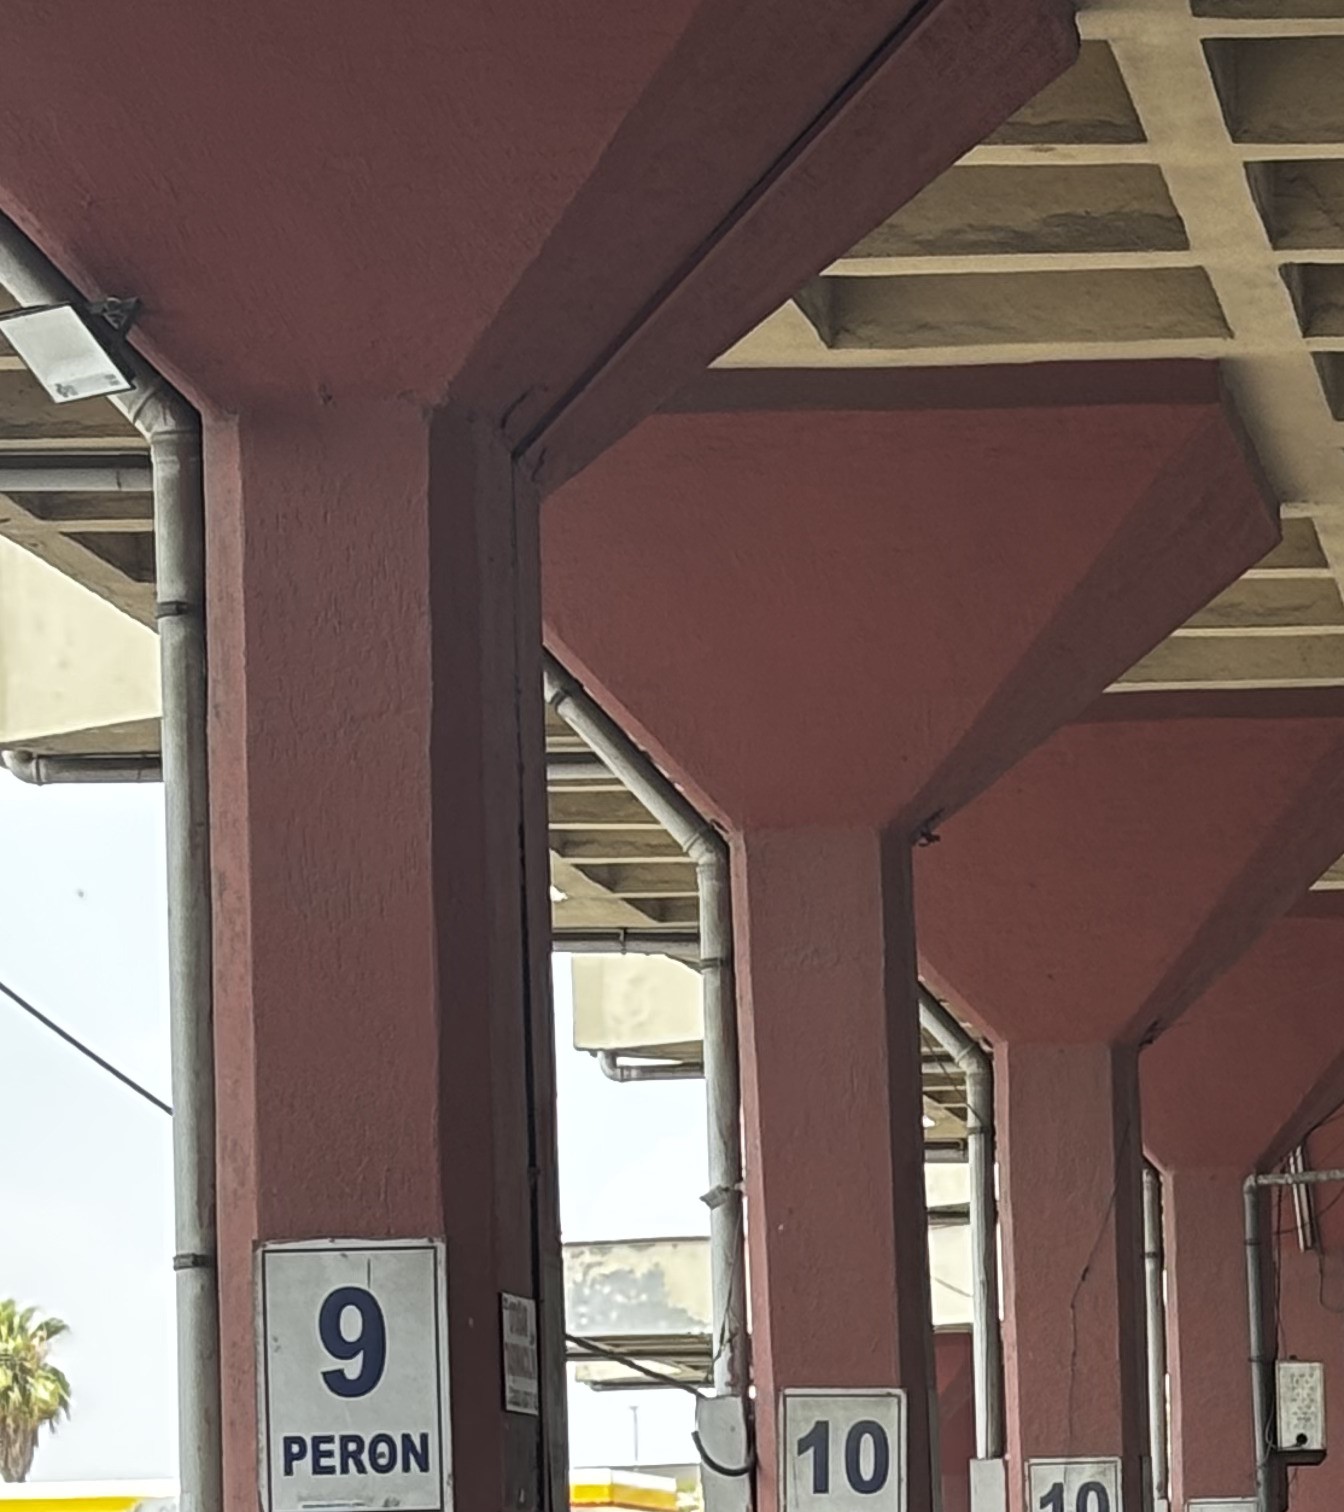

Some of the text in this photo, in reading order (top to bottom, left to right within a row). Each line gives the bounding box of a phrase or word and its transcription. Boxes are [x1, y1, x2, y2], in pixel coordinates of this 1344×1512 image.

[318, 1285, 387, 1399] 9
[282, 1432, 430, 1477] PERON
[796, 1419, 890, 1495] 10
